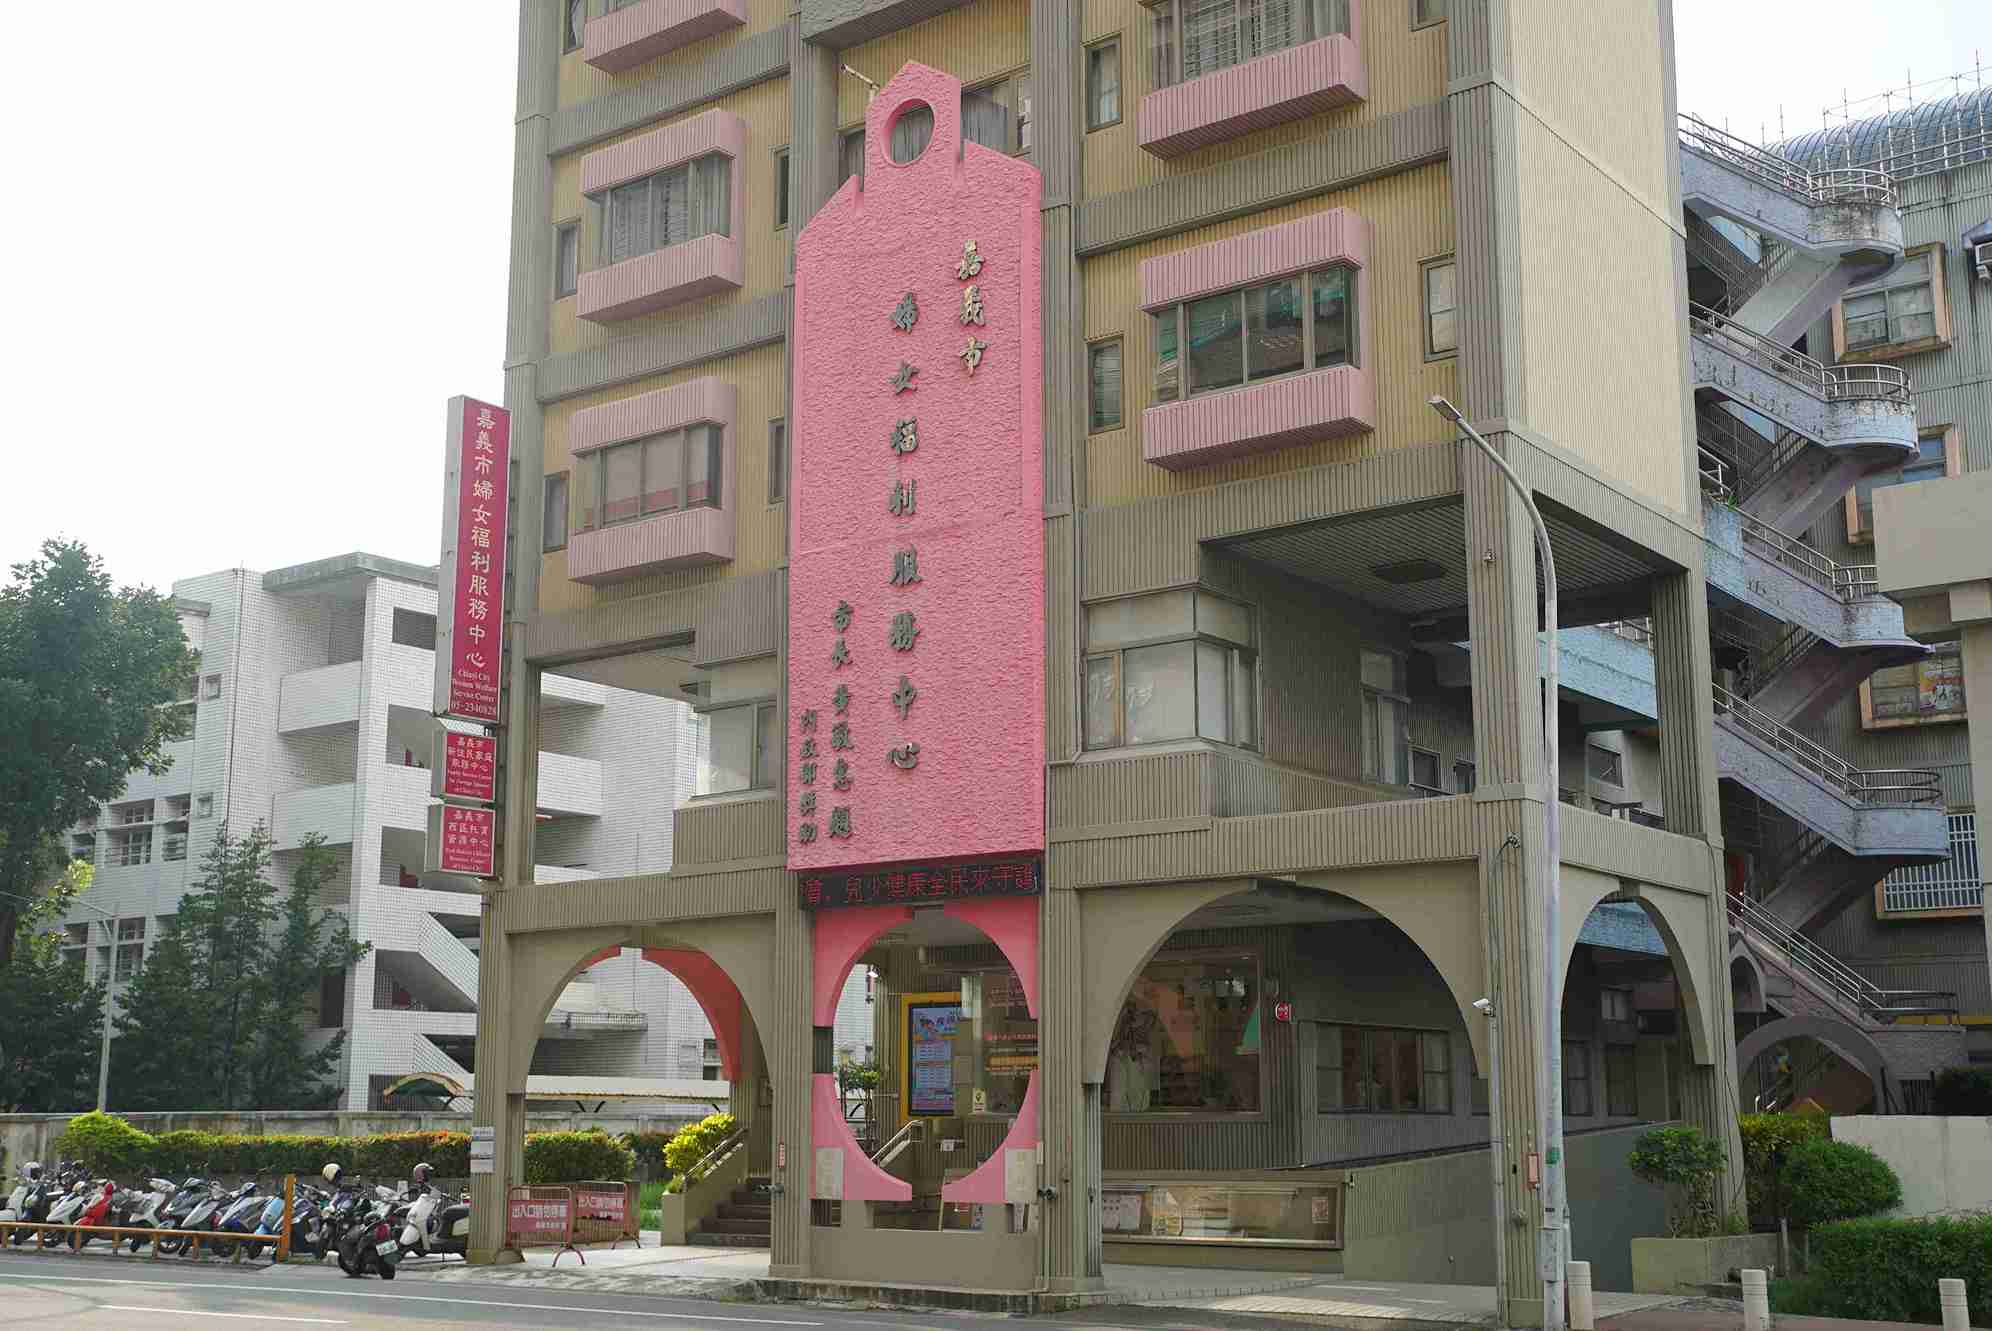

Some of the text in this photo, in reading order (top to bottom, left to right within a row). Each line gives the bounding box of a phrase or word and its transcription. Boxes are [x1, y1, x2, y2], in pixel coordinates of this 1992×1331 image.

[956, 239, 989, 377] 嘉義市
[465, 408, 497, 669] 嘉義市婦女福利服務中心
[887, 291, 923, 770] 婦女福利服務中心
